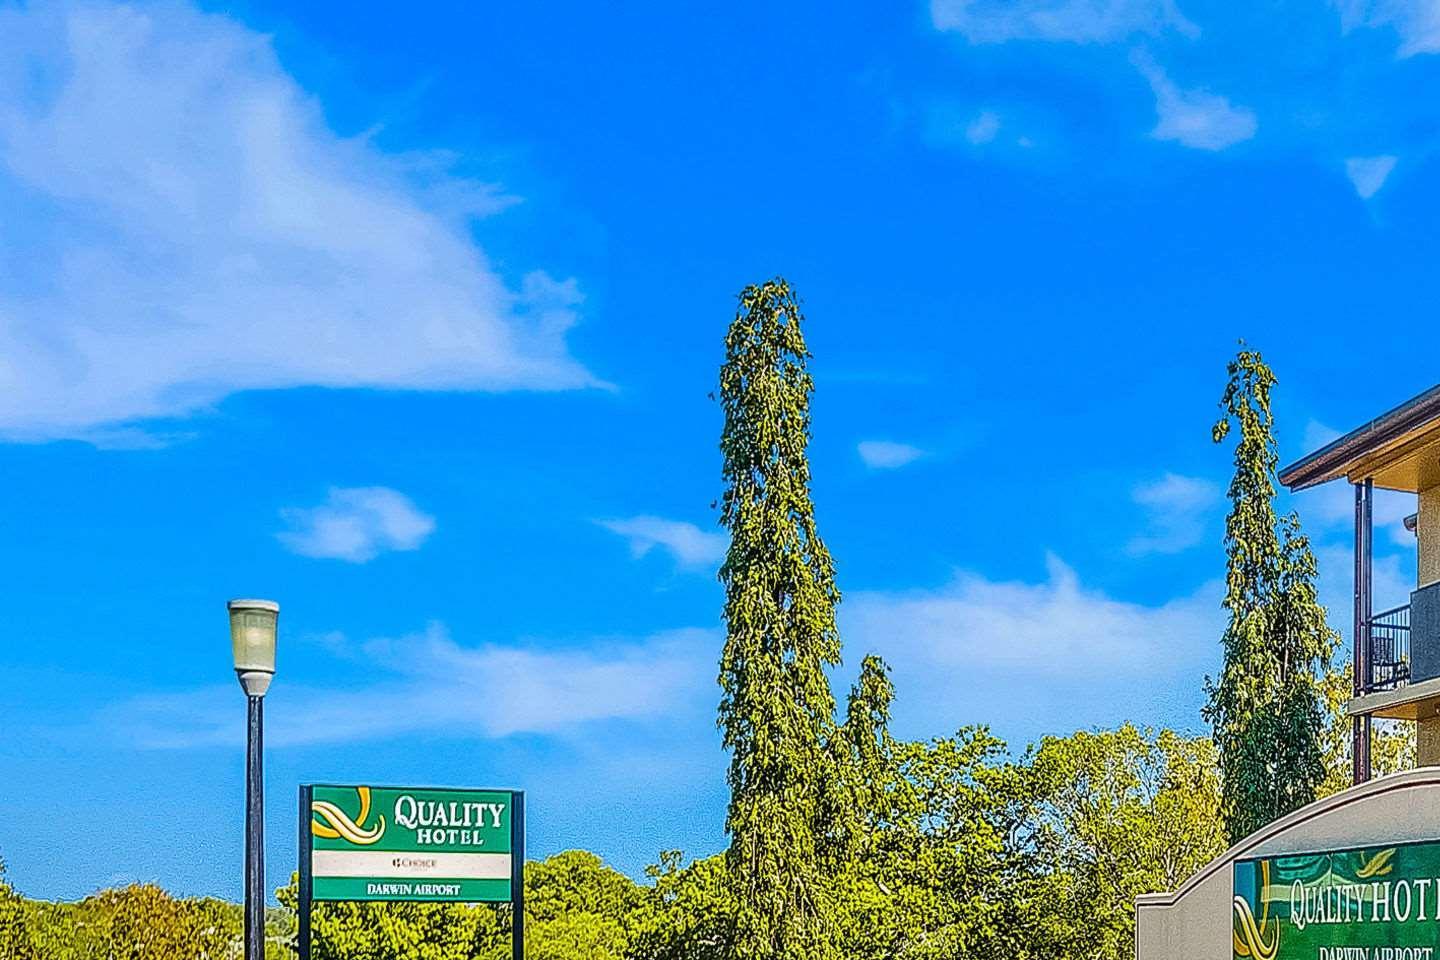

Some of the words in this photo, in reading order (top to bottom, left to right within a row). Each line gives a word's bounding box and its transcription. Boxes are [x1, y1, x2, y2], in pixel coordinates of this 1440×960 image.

[395, 796, 505, 829] QUALITY
[416, 829, 484, 845] HOTEL
[367, 883, 412, 895] DARWIN
[413, 884, 461, 896] AIRPORT
[1290, 878, 1367, 930] QUALITY
